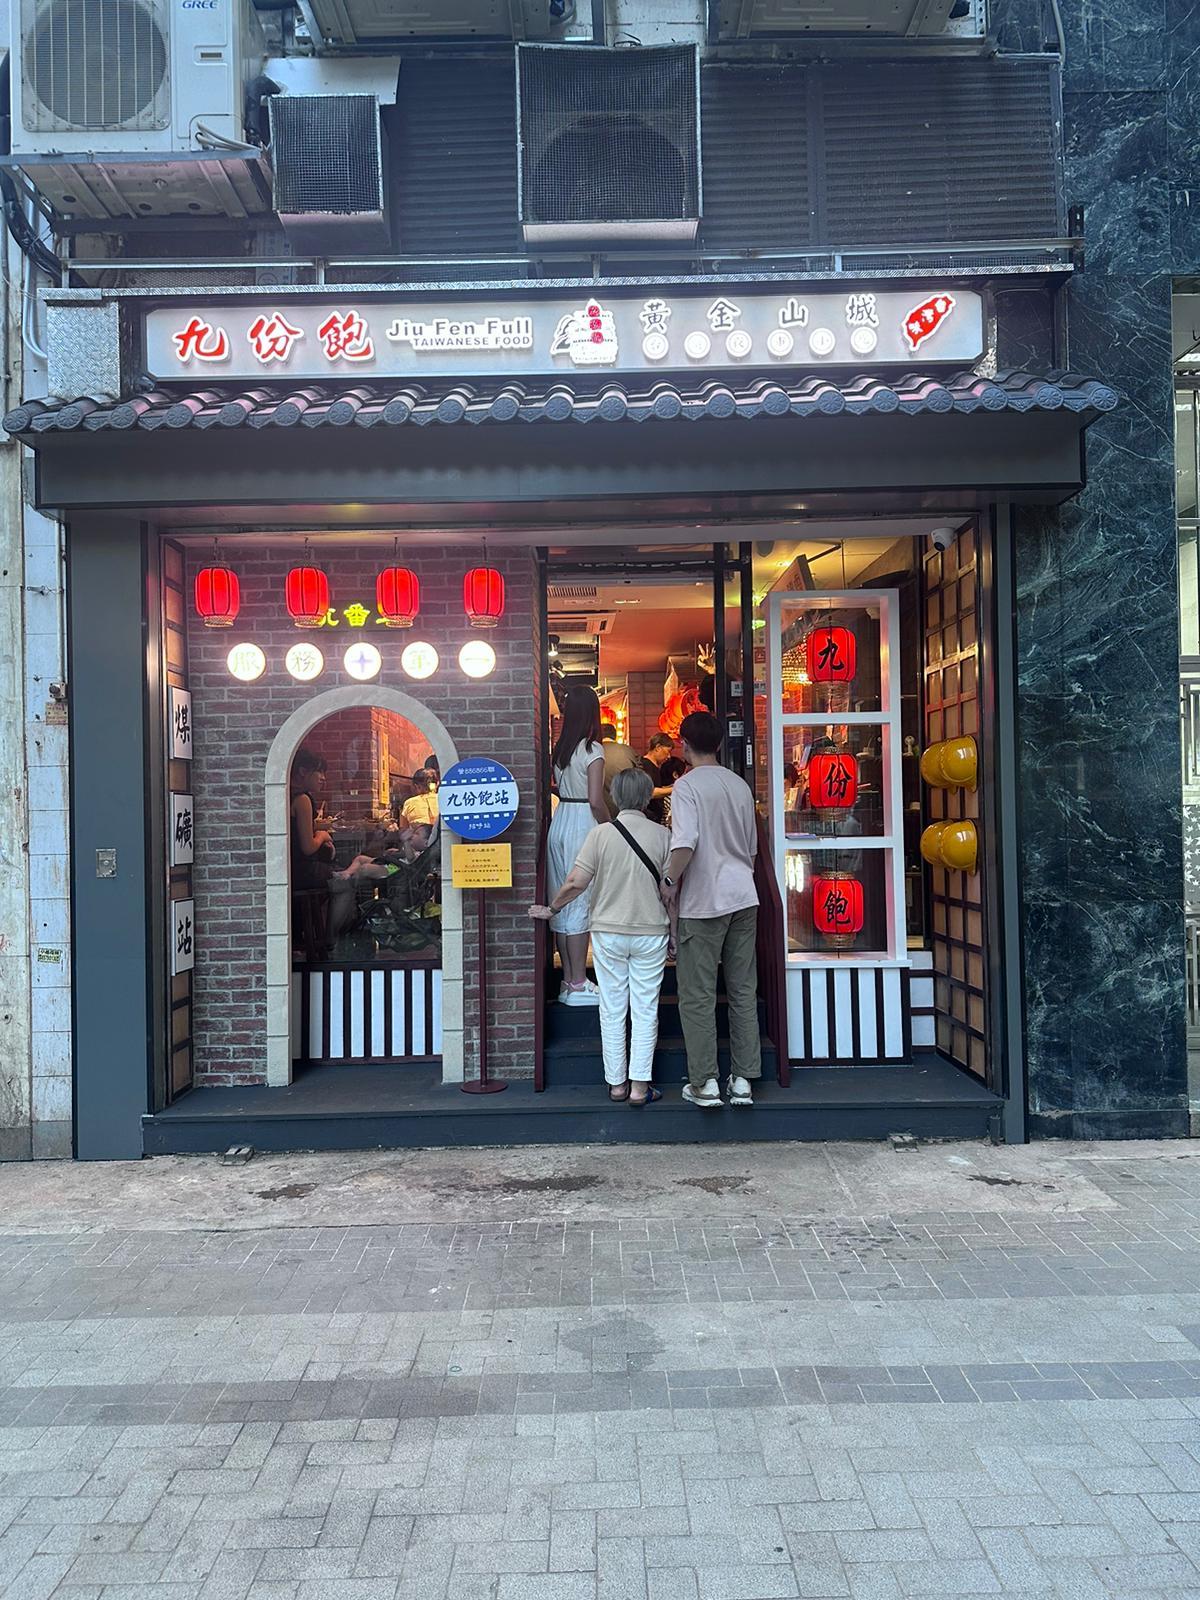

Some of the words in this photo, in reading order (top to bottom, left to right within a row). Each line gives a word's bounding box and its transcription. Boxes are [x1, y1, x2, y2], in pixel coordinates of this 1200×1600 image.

[182, 0, 218, 9] GREE
[389, 320, 424, 337] Jiu
[434, 320, 476, 336] Fen
[487, 318, 531, 336] Full
[174, 310, 374, 362] 九份飽
[413, 337, 490, 347] TAIWANESE
[494, 336, 531, 346] FOOD
[447, 790, 509, 806] 九份飽站
